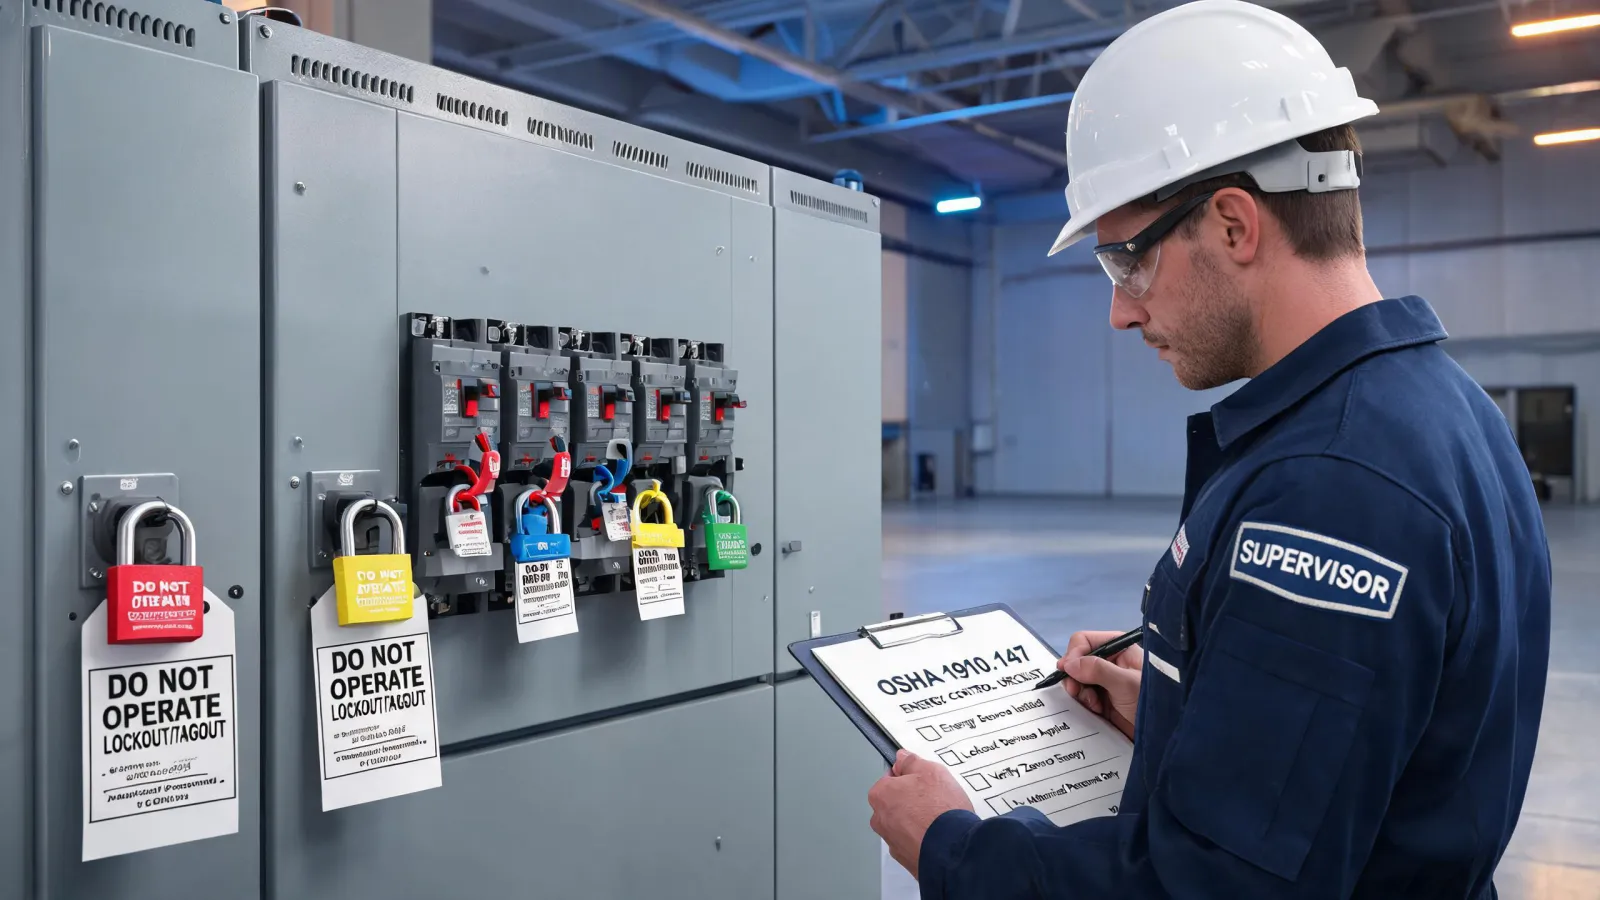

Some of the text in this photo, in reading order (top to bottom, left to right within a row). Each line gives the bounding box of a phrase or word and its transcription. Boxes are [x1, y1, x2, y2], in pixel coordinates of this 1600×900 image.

[133, 580, 190, 594] DO NOT
[1240, 539, 1390, 603] SUPERVISOR
[332, 640, 415, 674] DO NOT
[877, 645, 1030, 696] OSHA 1910.147
[108, 665, 213, 700] DO NOT
[330, 665, 425, 700] OPERATE
[102, 693, 222, 730] OPERATE
